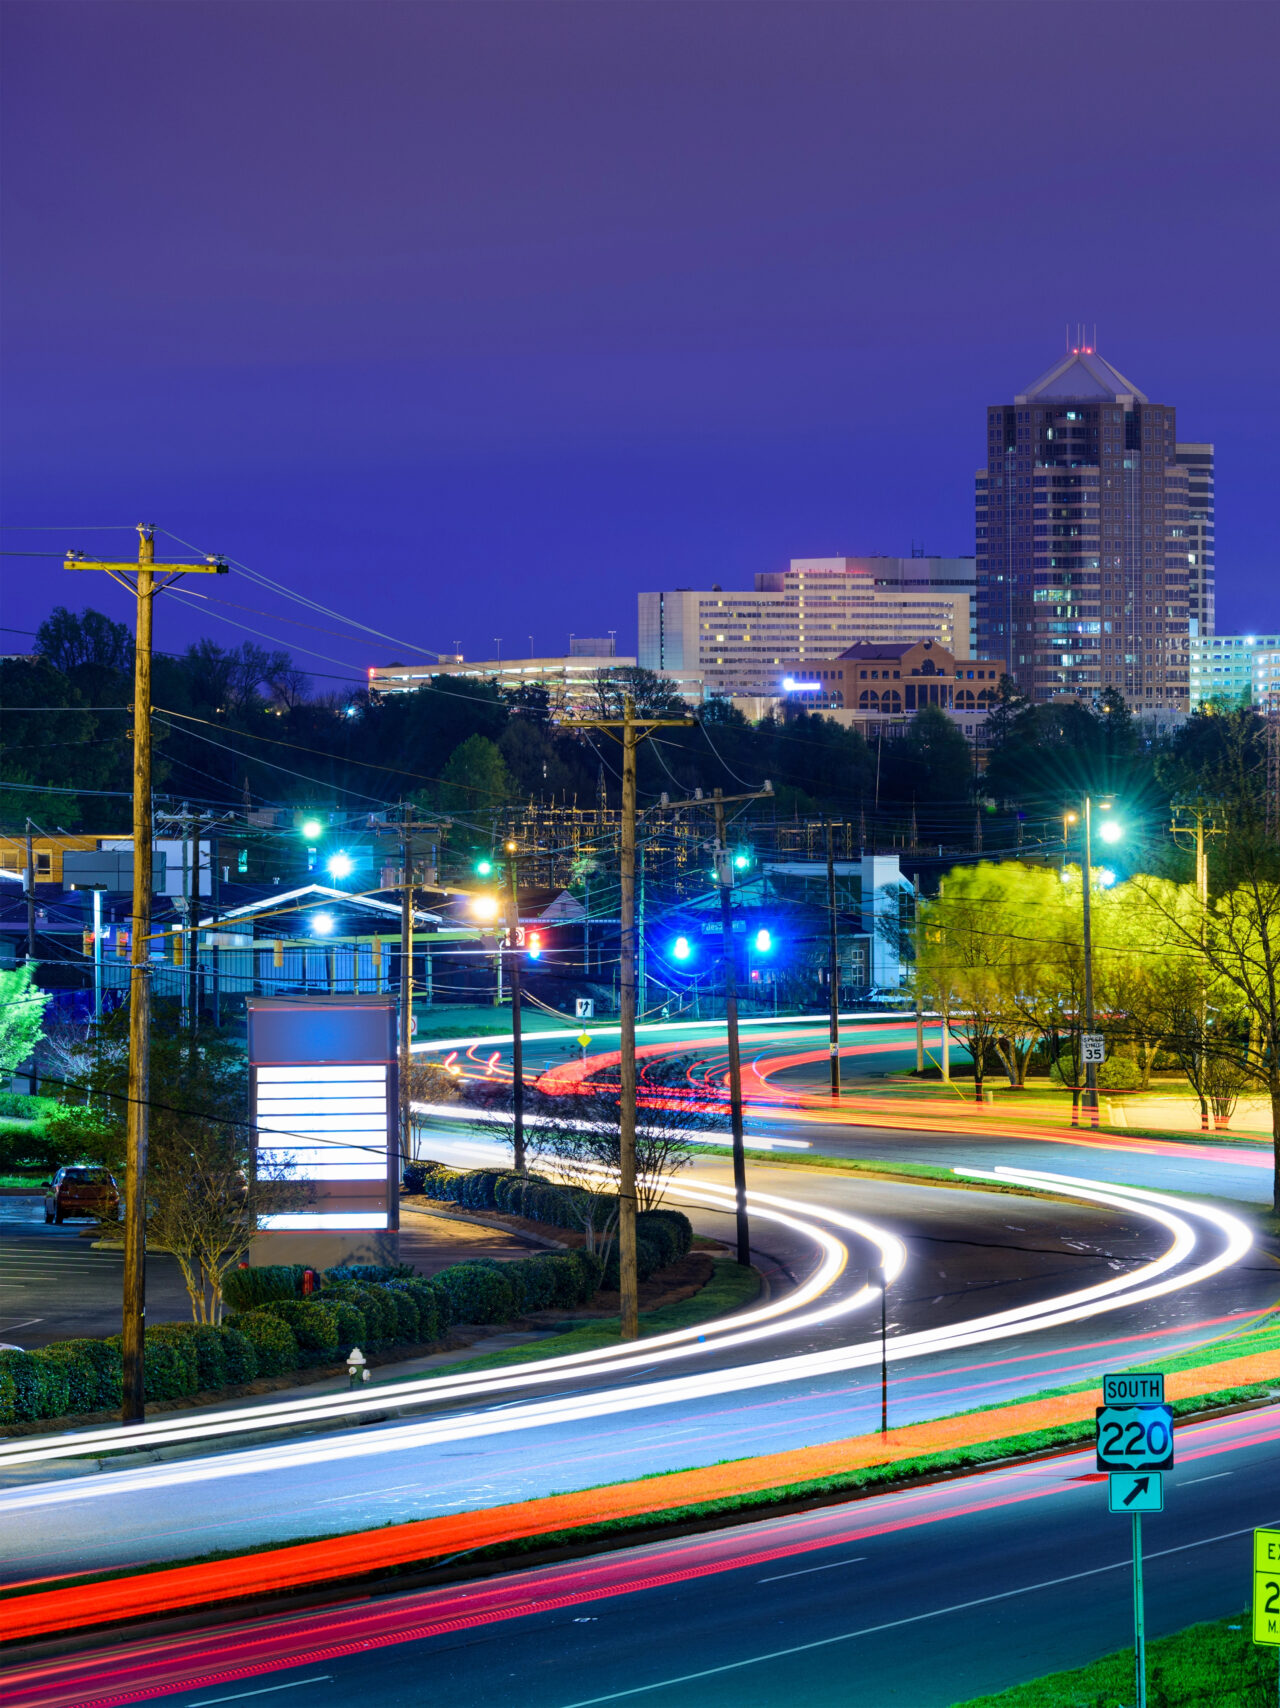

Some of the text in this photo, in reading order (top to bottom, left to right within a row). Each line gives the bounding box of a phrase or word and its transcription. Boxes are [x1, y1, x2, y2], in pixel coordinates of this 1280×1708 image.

[1086, 1049, 1101, 1059] 35
[1108, 1381, 1160, 1398] SOUTH
[1103, 1422, 1169, 1455] 220
